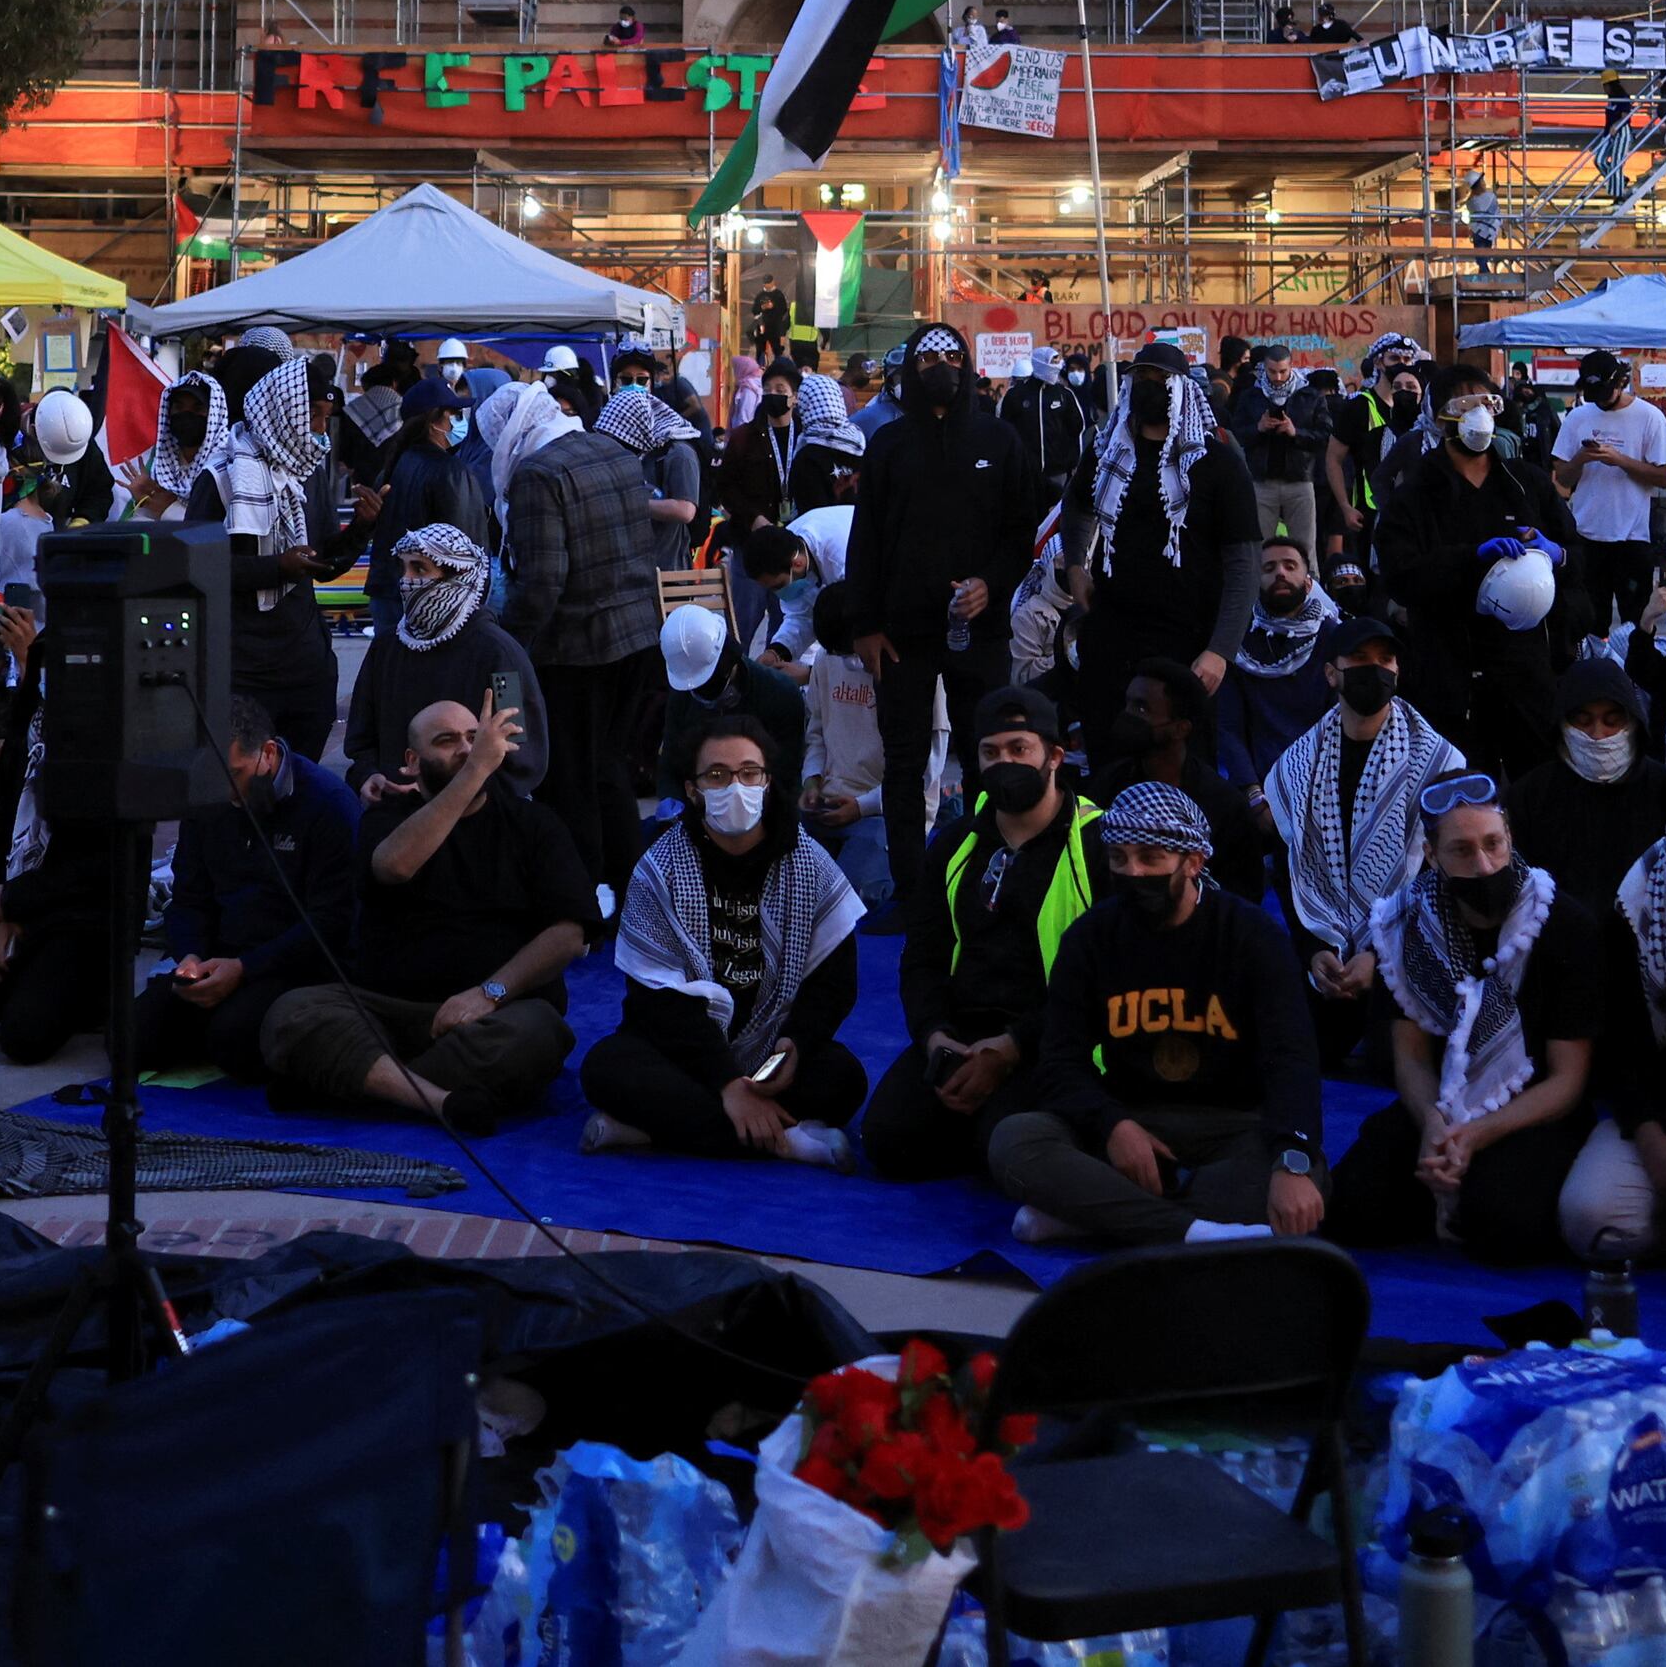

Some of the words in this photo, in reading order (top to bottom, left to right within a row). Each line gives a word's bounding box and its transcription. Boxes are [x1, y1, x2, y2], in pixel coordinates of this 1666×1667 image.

[1015, 49, 1041, 64] END
[1046, 52, 1063, 67] US
[1010, 64, 1062, 79] IMPERIALISM
[1018, 79, 1045, 90] FREE
[1008, 86, 1056, 103] PALESTINE
[977, 105, 997, 115] THEY
[990, 96, 1011, 109] TRIED
[1026, 102, 1044, 113] BURY
[979, 115, 991, 123] WE
[997, 117, 1022, 129] WERE
[1045, 309, 1147, 341] BLOOD
[1211, 310, 1277, 338] YOUR
[1290, 310, 1378, 339] HANDS
[1106, 987, 1241, 1042] UCLA
